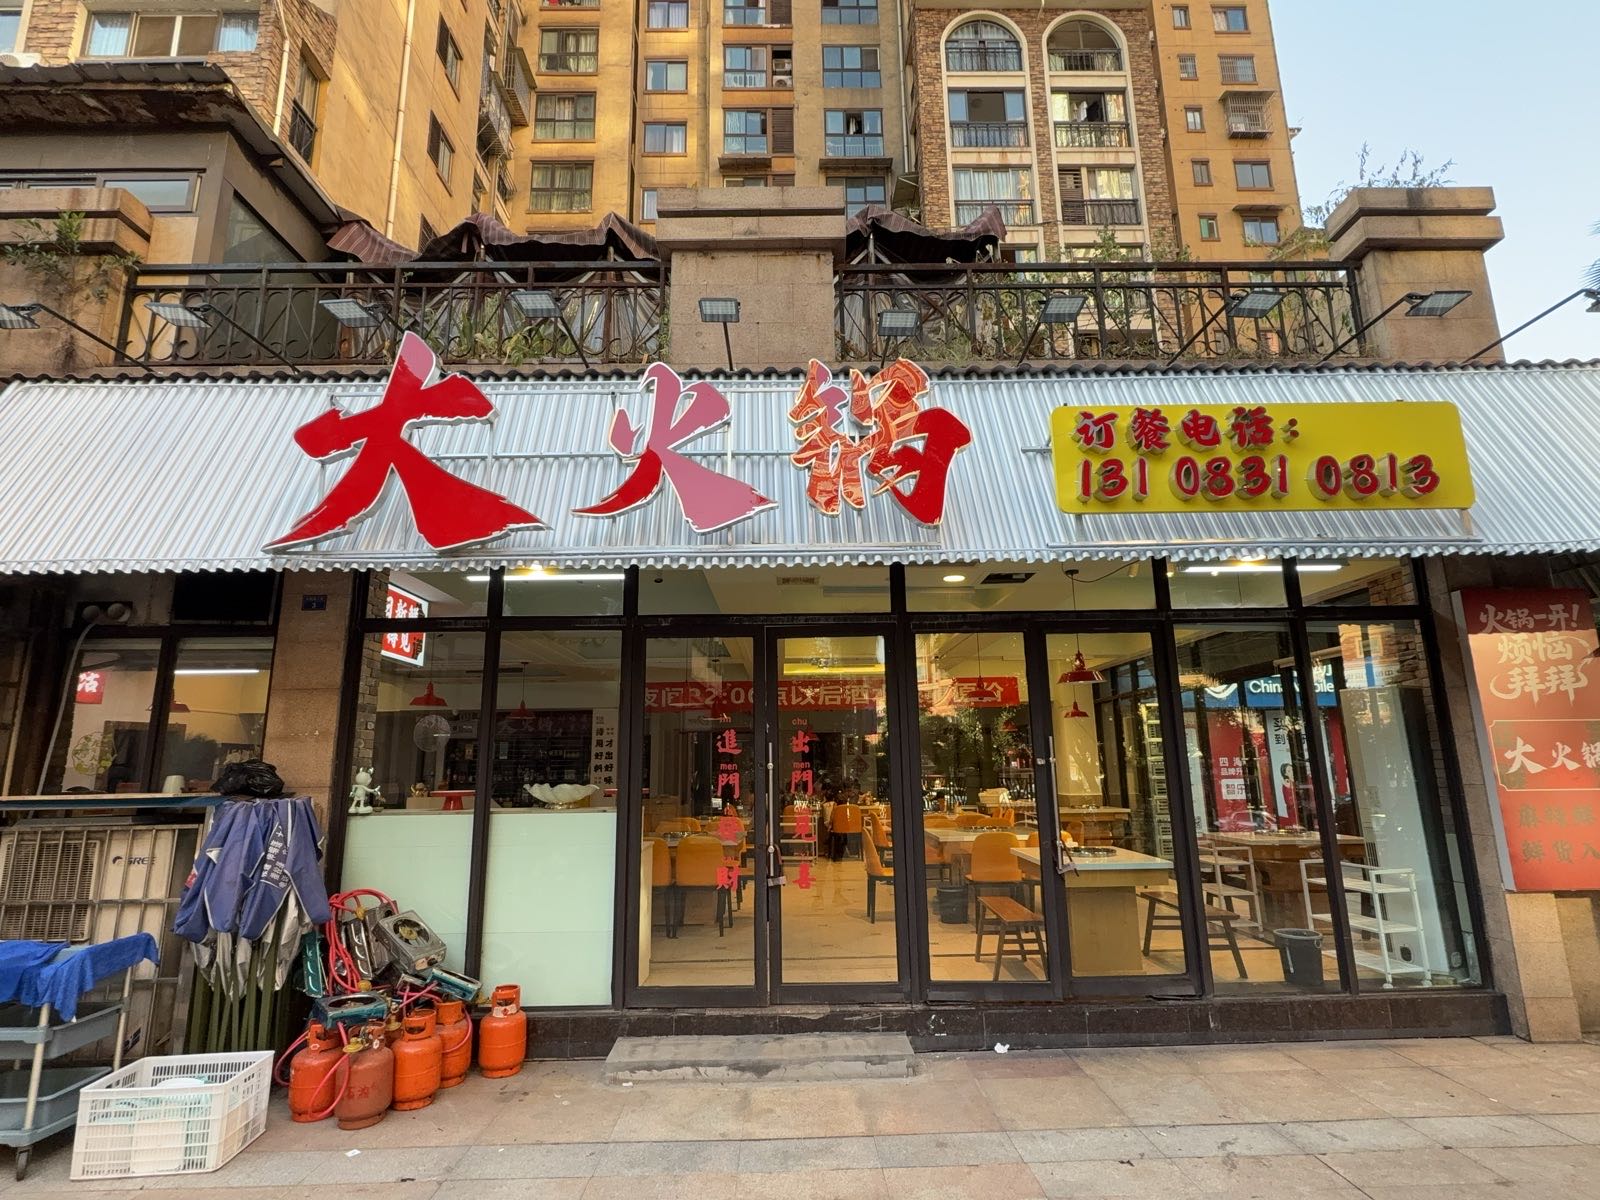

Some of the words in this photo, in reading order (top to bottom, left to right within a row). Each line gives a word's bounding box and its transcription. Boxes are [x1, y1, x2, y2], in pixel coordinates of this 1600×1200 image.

[262, 330, 972, 553] 大火锅
[1077, 456, 1150, 502] 131
[1168, 454, 1290, 502] 0831
[1307, 453, 1440, 501] 0813
[1497, 634, 1574, 665] 烦恼
[1249, 680, 1283, 693] Chin
[1489, 664, 1588, 706] 拜拜
